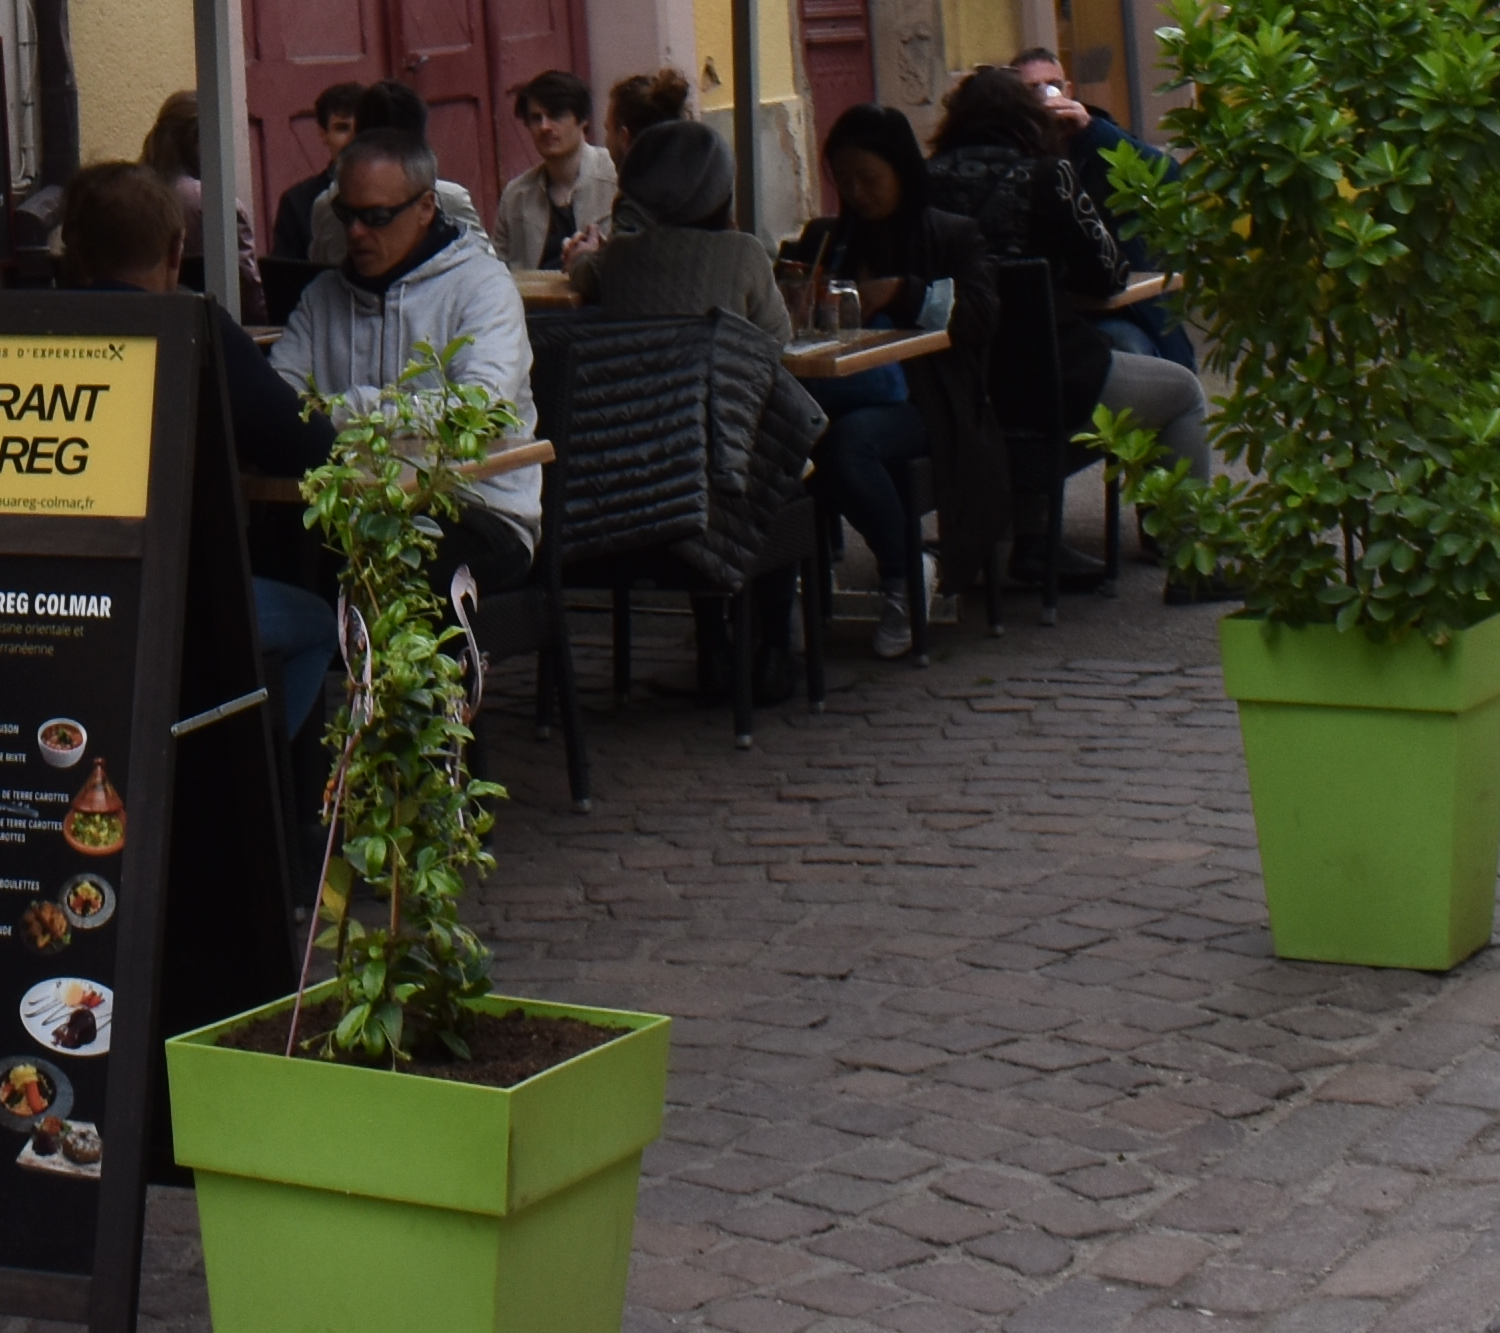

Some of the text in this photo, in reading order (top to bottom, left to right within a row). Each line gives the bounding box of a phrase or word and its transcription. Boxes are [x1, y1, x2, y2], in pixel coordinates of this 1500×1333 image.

[33, 592, 113, 619] COLMAR
[25, 621, 72, 636] orientale
[73, 624, 85, 637] et
